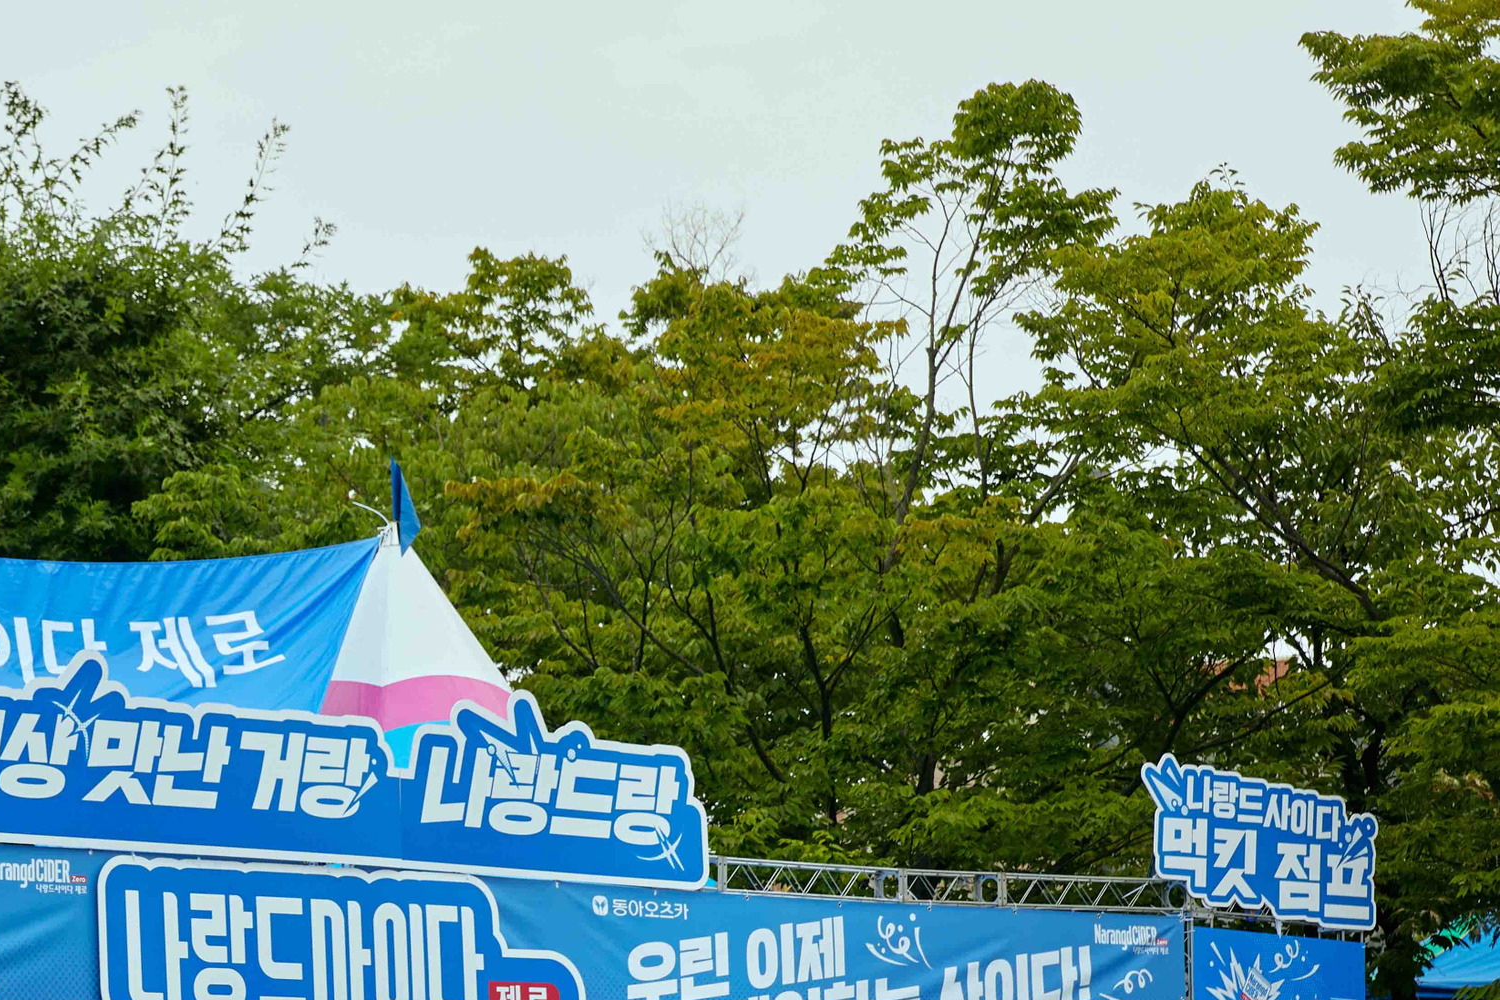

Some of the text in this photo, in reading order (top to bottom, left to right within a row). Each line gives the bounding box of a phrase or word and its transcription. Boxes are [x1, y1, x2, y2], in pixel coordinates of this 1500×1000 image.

[130, 611, 285, 689] 제로
[84, 719, 230, 810] 맛난
[241, 731, 373, 820] 거랑
[421, 734, 680, 845] 나랑드랑
[1186, 775, 1341, 843] 나랑드사이다
[36, 884, 87, 894] 나랑드사이다 제로
[1162, 817, 1370, 921] 먹킷 점프
[612, 901, 688, 920] 동아오츠카
[746, 917, 845, 990] 이제
